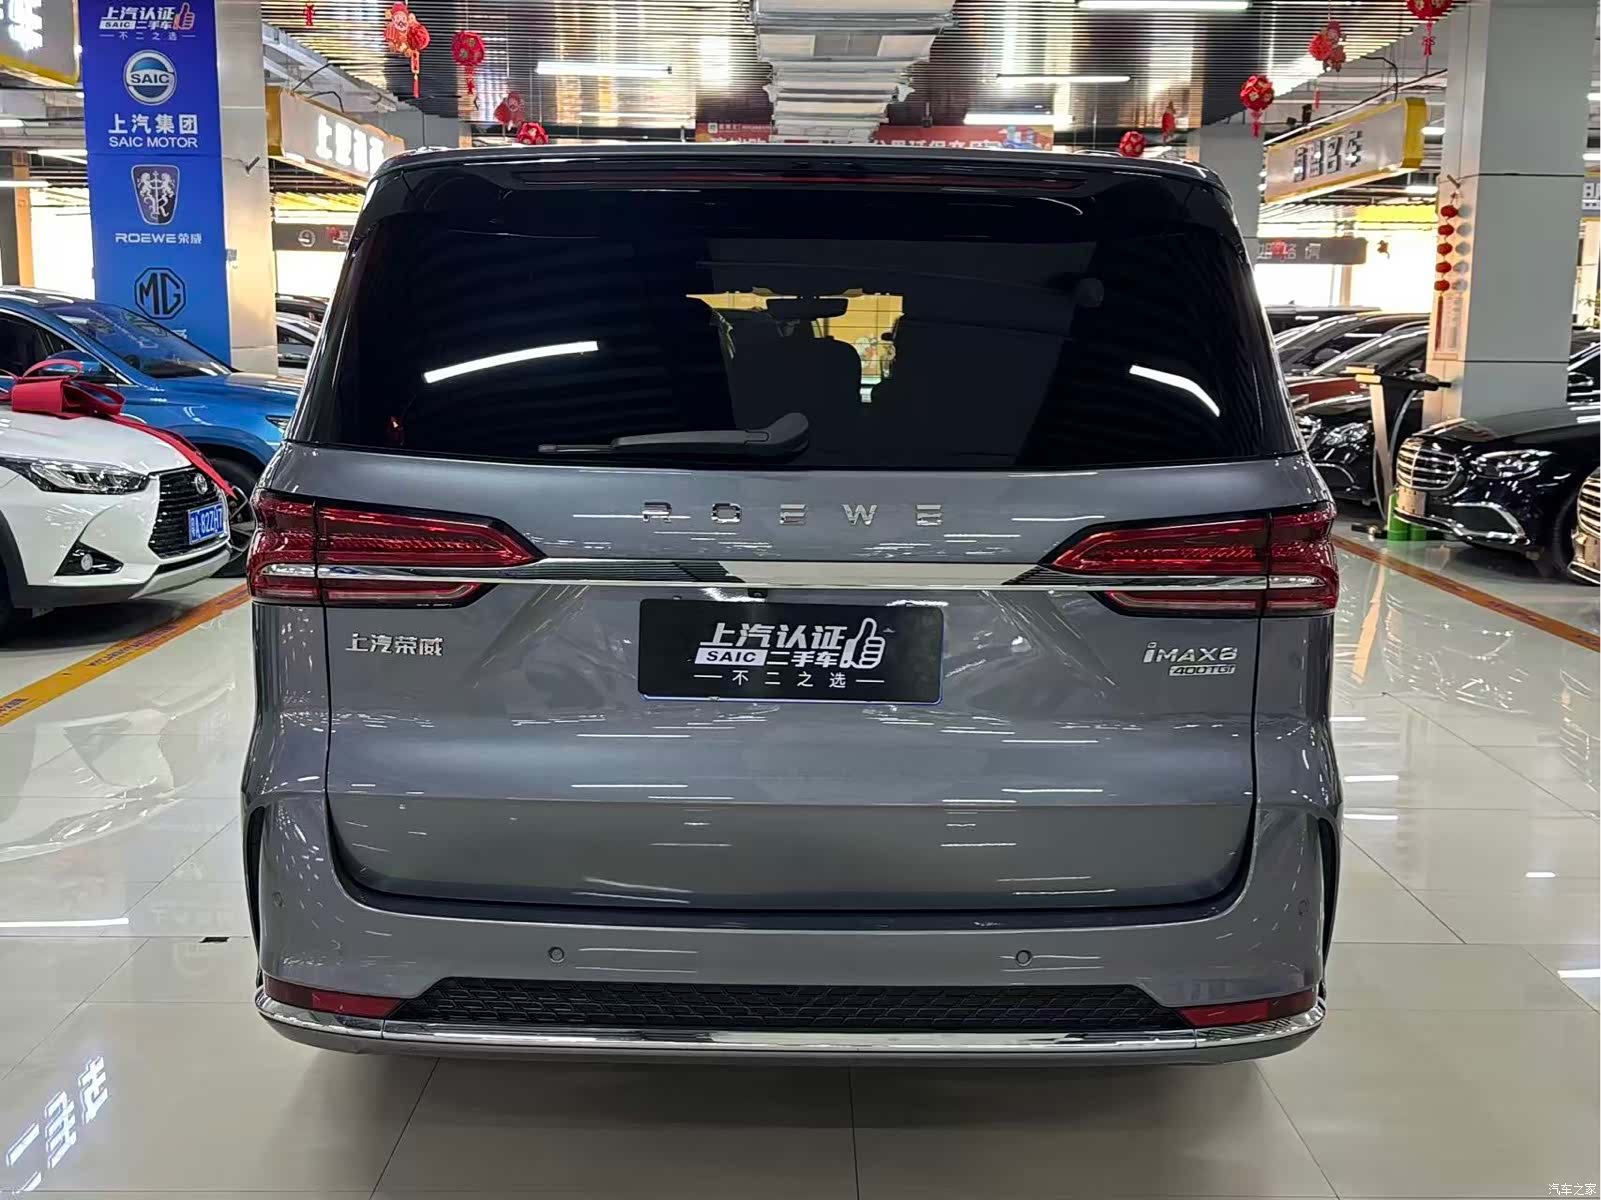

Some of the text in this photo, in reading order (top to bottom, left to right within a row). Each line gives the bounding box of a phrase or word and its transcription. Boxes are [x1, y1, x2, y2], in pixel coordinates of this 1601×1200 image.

[101, 6, 176, 20] 上汽认证
[136, 20, 173, 30] 二手车
[131, 73, 170, 84] SAIC
[108, 113, 198, 134] 上汽集团
[109, 136, 198, 148] SAIC MOTOR
[138, 272, 181, 316] MG
[642, 501, 944, 527] ROEWE
[344, 632, 444, 656] 上汽荣威
[700, 622, 848, 649] 上汽认证
[706, 650, 840, 667] SAIC 二手车
[732, 669, 847, 689] 不二之选
